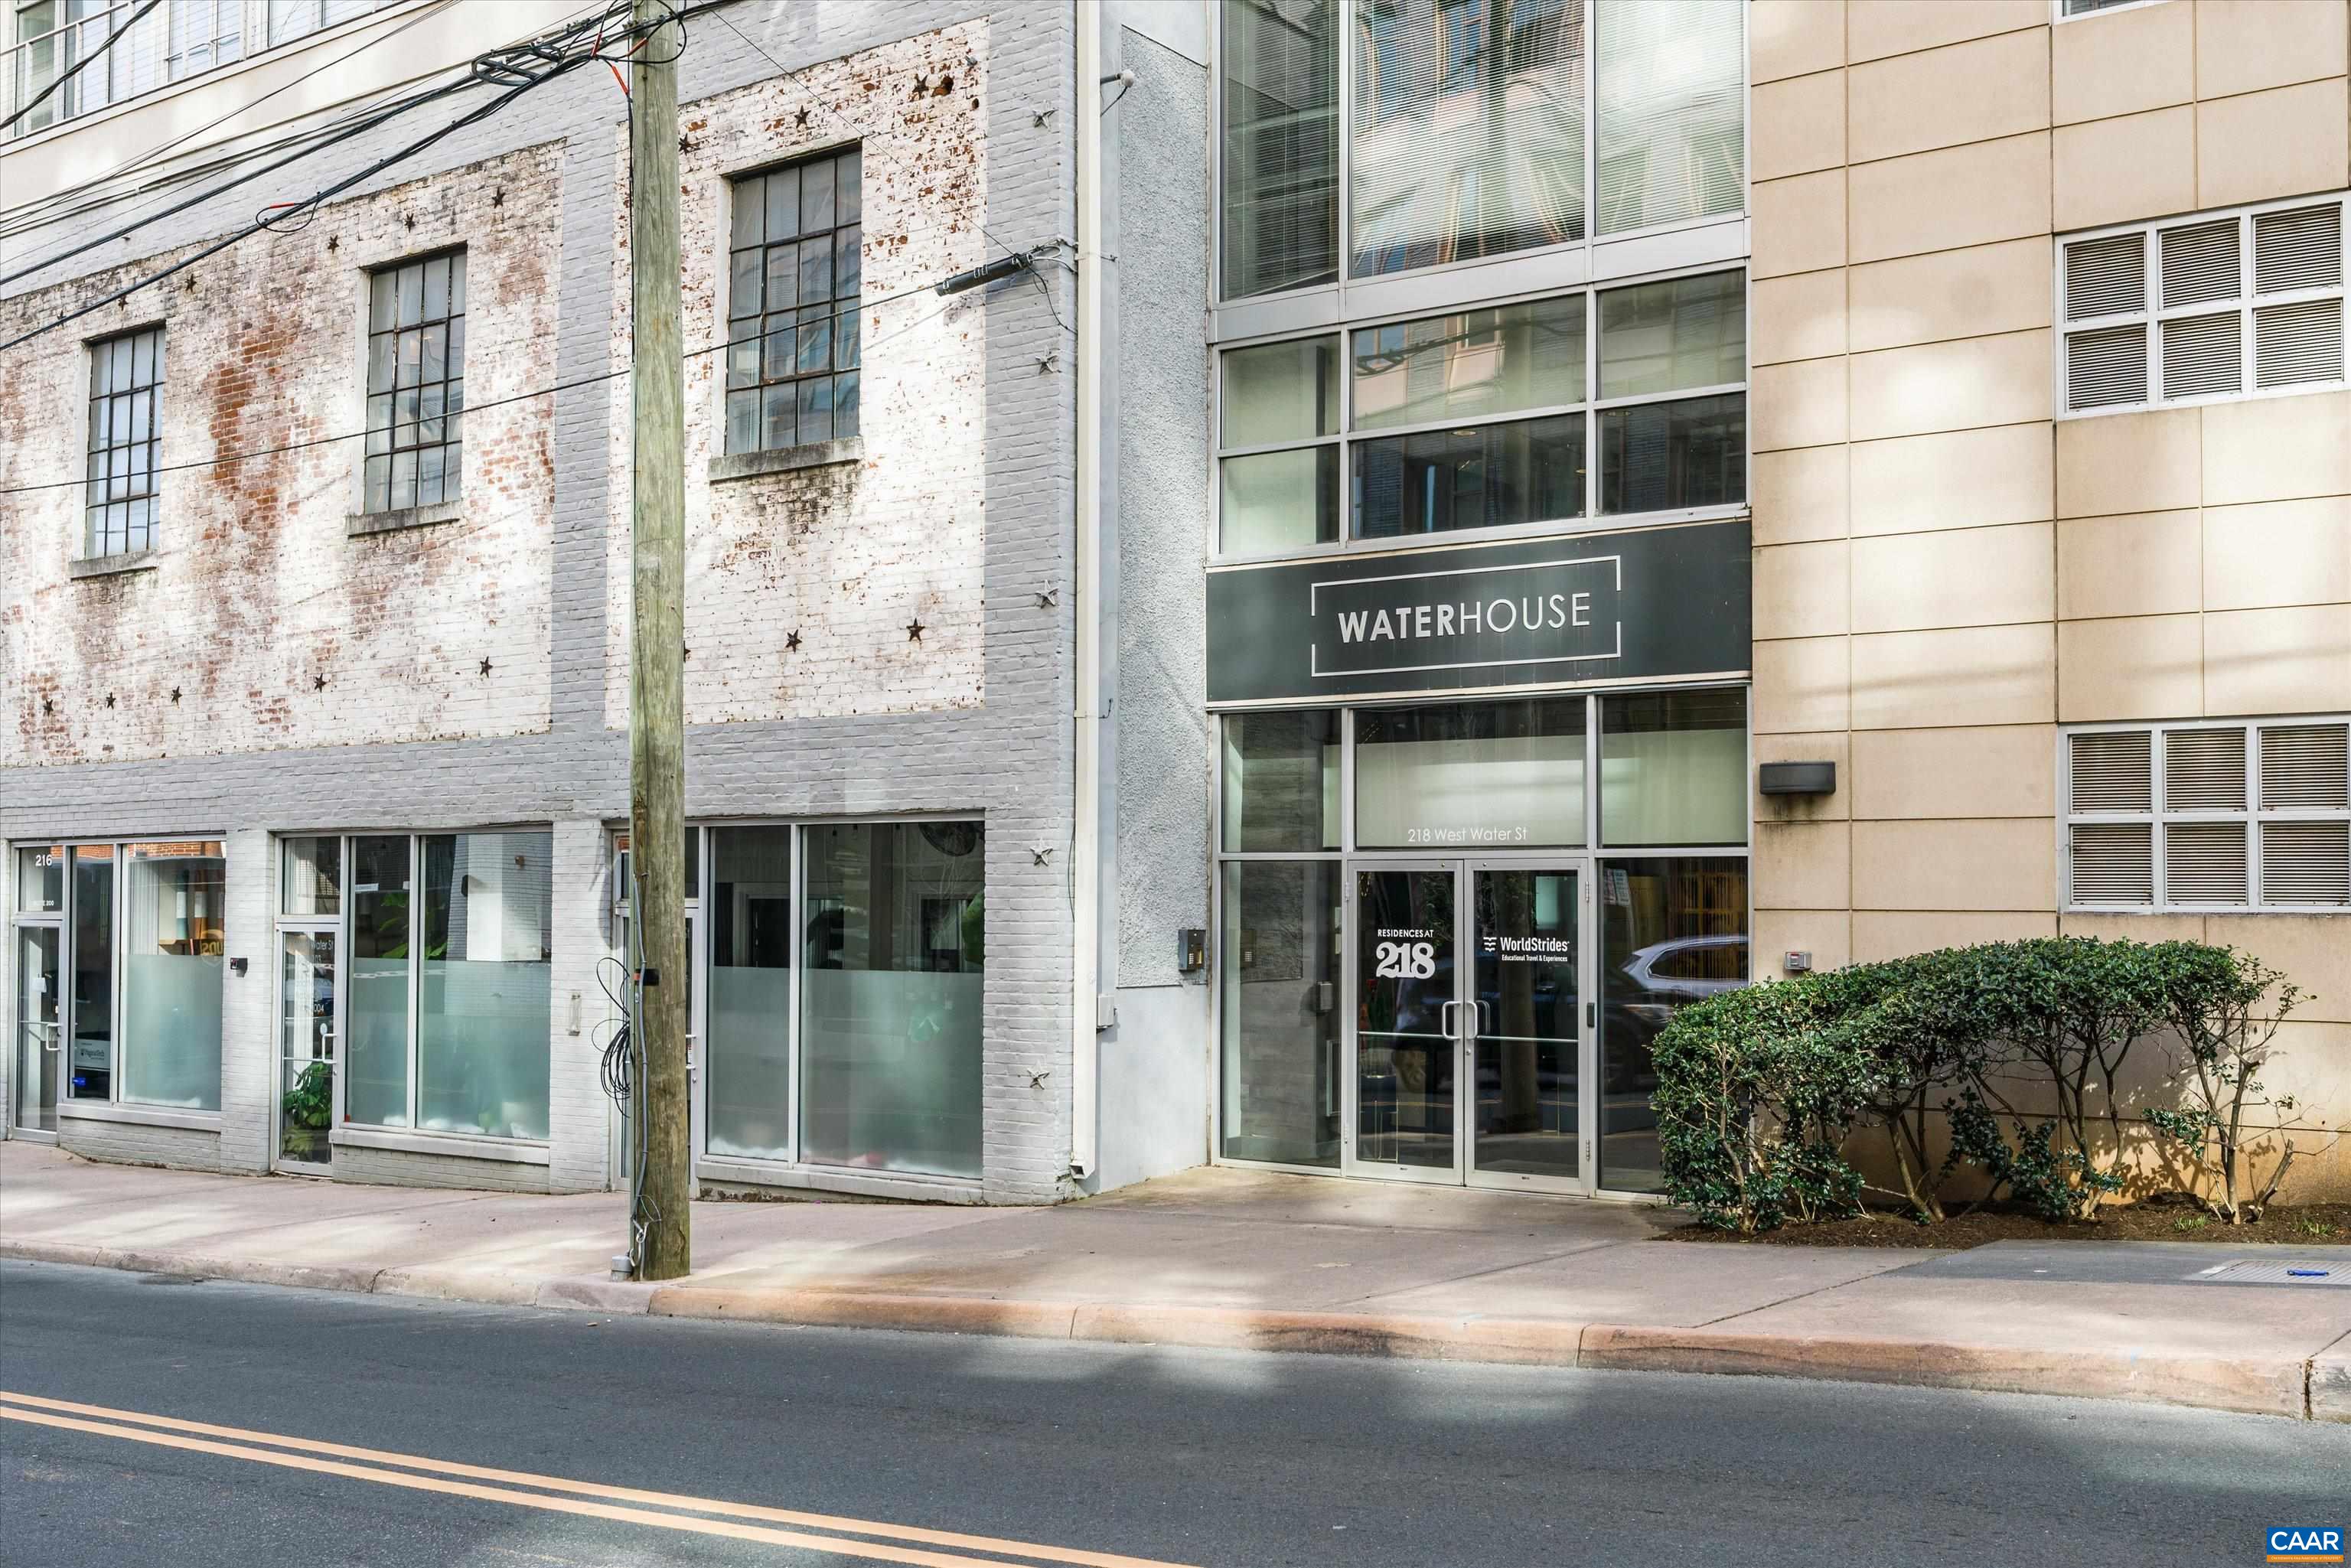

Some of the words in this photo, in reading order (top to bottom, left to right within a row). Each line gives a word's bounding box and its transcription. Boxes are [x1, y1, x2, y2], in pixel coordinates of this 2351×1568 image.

[1339, 593, 1590, 644] WATERHOUSE
[1407, 828, 1431, 843] 218
[1434, 827, 1467, 842] West
[1470, 826, 1511, 841] Water
[1515, 826, 1528, 841] St
[35, 854, 52, 866] 216
[1378, 928, 1423, 937] RESIDENCES
[1423, 929, 1434, 938] AT
[1500, 937, 1568, 952] WorldStrides
[1376, 941, 1436, 980] 218
